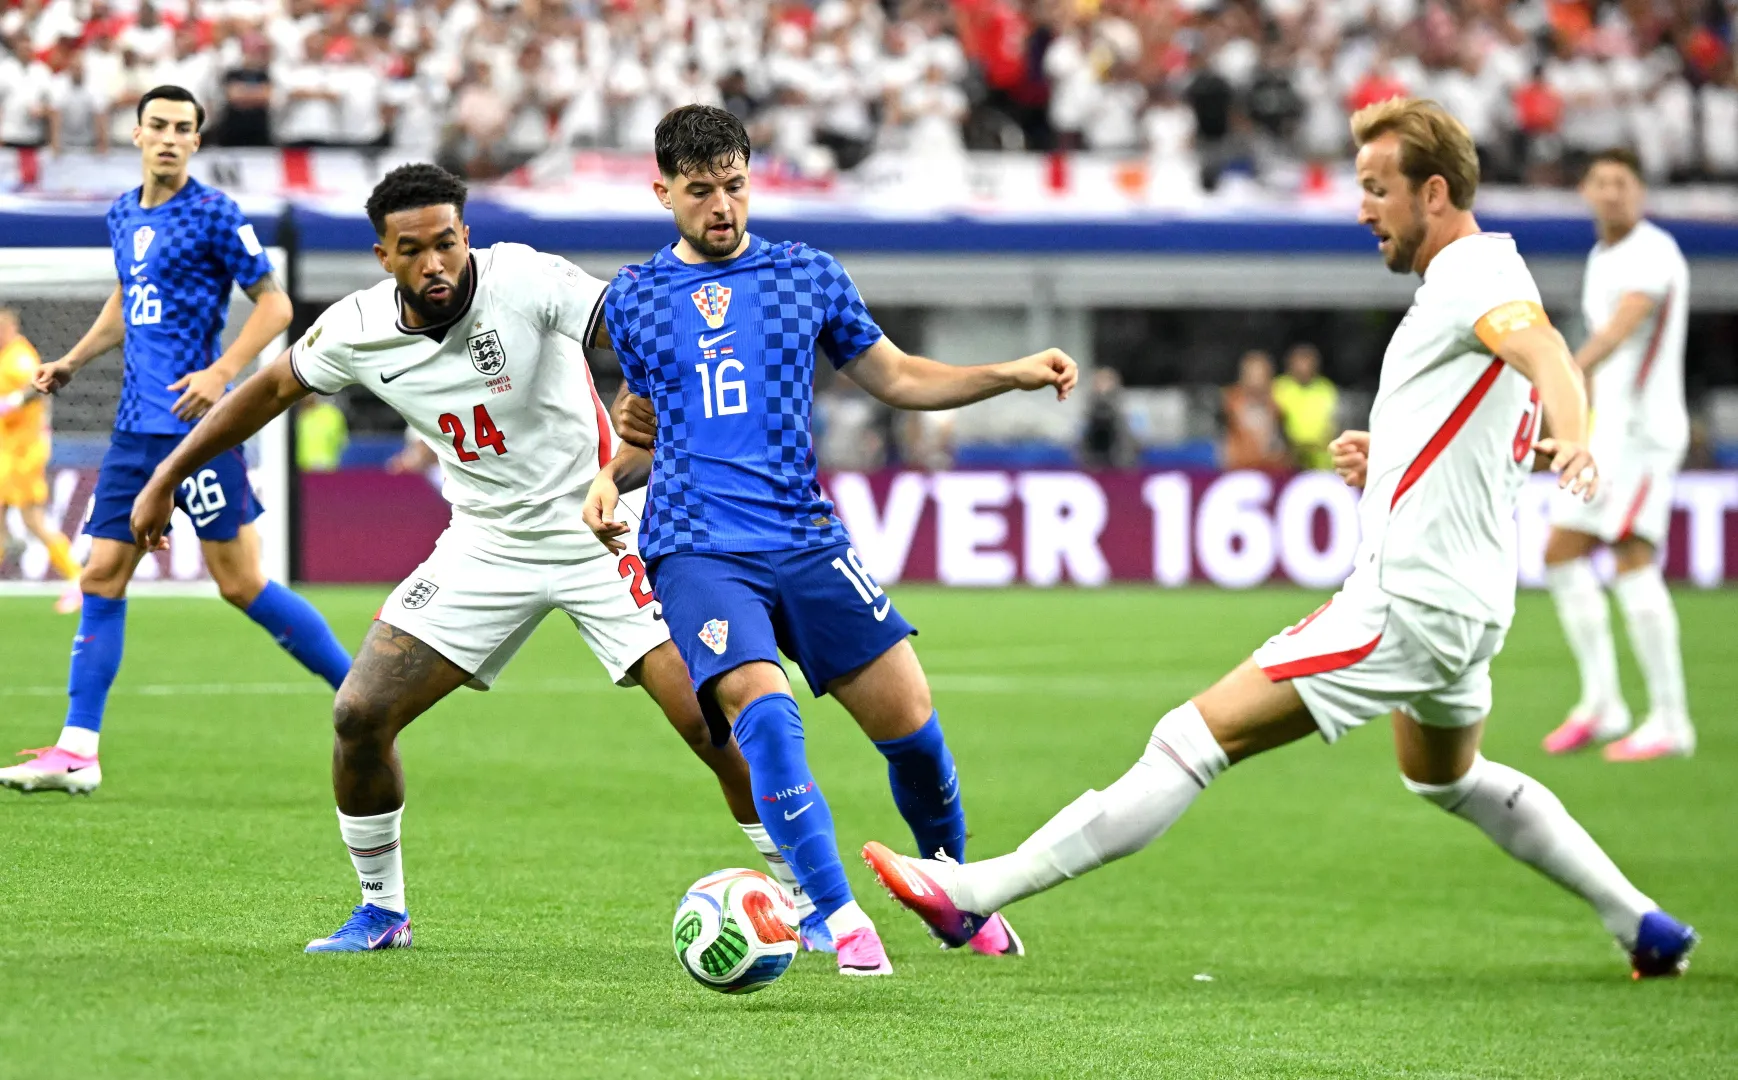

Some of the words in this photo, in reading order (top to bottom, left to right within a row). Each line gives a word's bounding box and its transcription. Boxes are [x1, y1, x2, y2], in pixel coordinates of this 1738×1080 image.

[129, 284, 162, 326] 26
[485, 375, 511, 387] CROATIA
[695, 358, 748, 418] 16
[438, 404, 508, 462] 24
[181, 468, 227, 515] 26
[1142, 470, 1362, 588] 160
[775, 784, 807, 801] HNS
[361, 881, 383, 891] ENG
